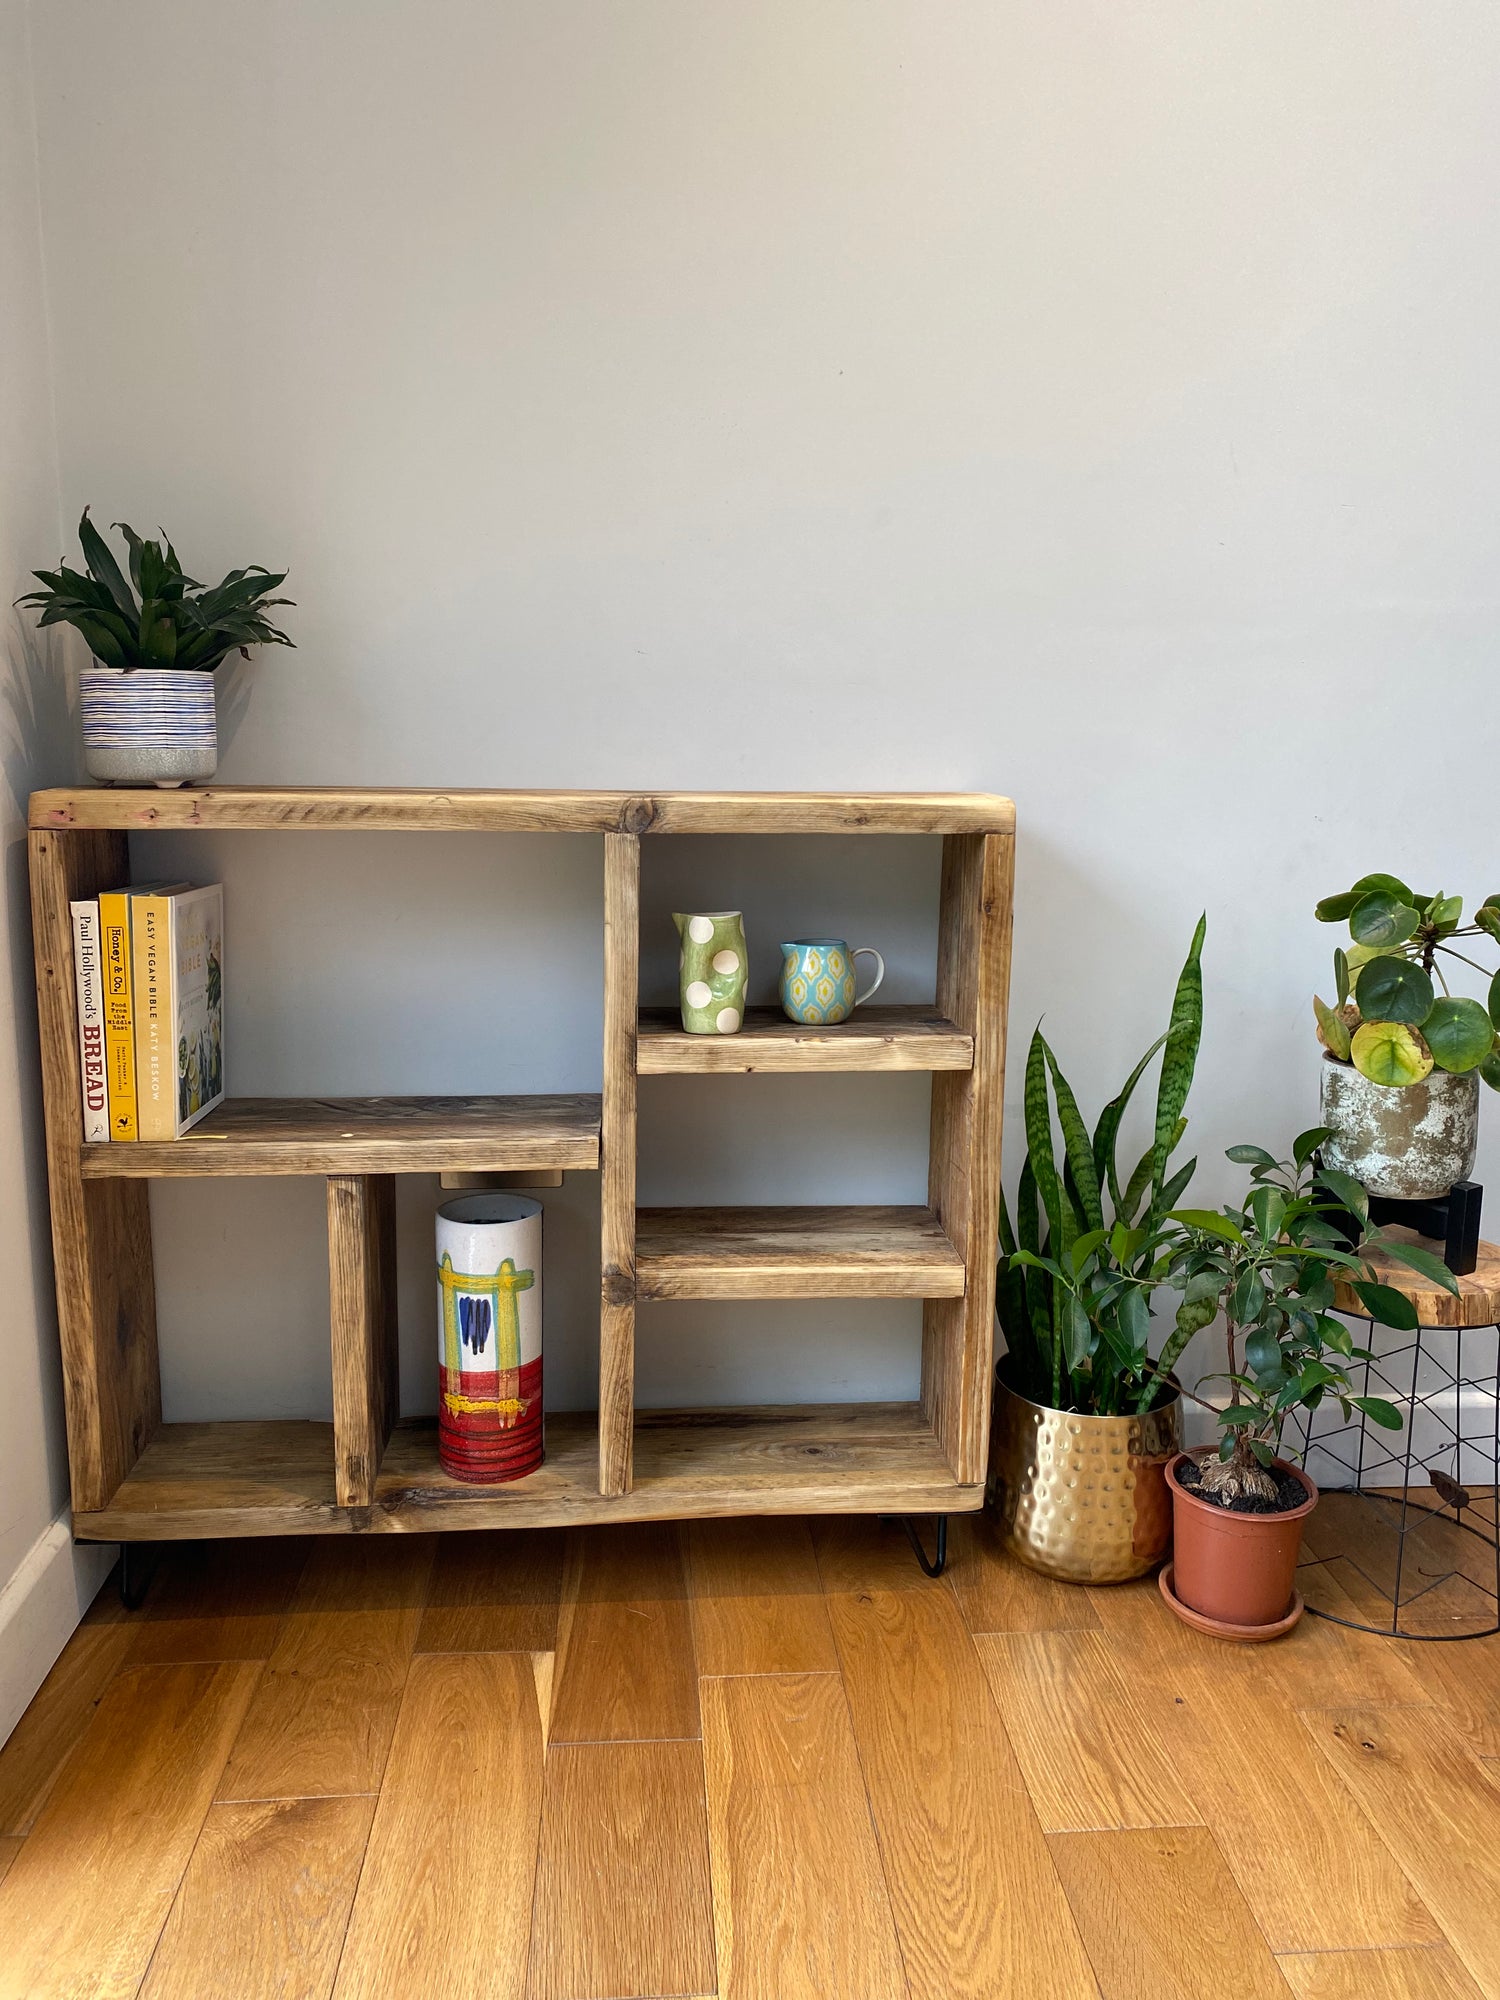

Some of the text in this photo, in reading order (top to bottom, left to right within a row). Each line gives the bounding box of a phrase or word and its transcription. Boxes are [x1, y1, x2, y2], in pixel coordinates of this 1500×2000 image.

[80, 916, 97, 1019] Paul Hollywood's
[110, 928, 123, 993] Honey & Co.
[181, 953, 201, 976] BIBLE
[147, 912, 160, 1101] EASY VEGAN BIBLE KATY BESKOW
[83, 1024, 105, 1112] BREAD
